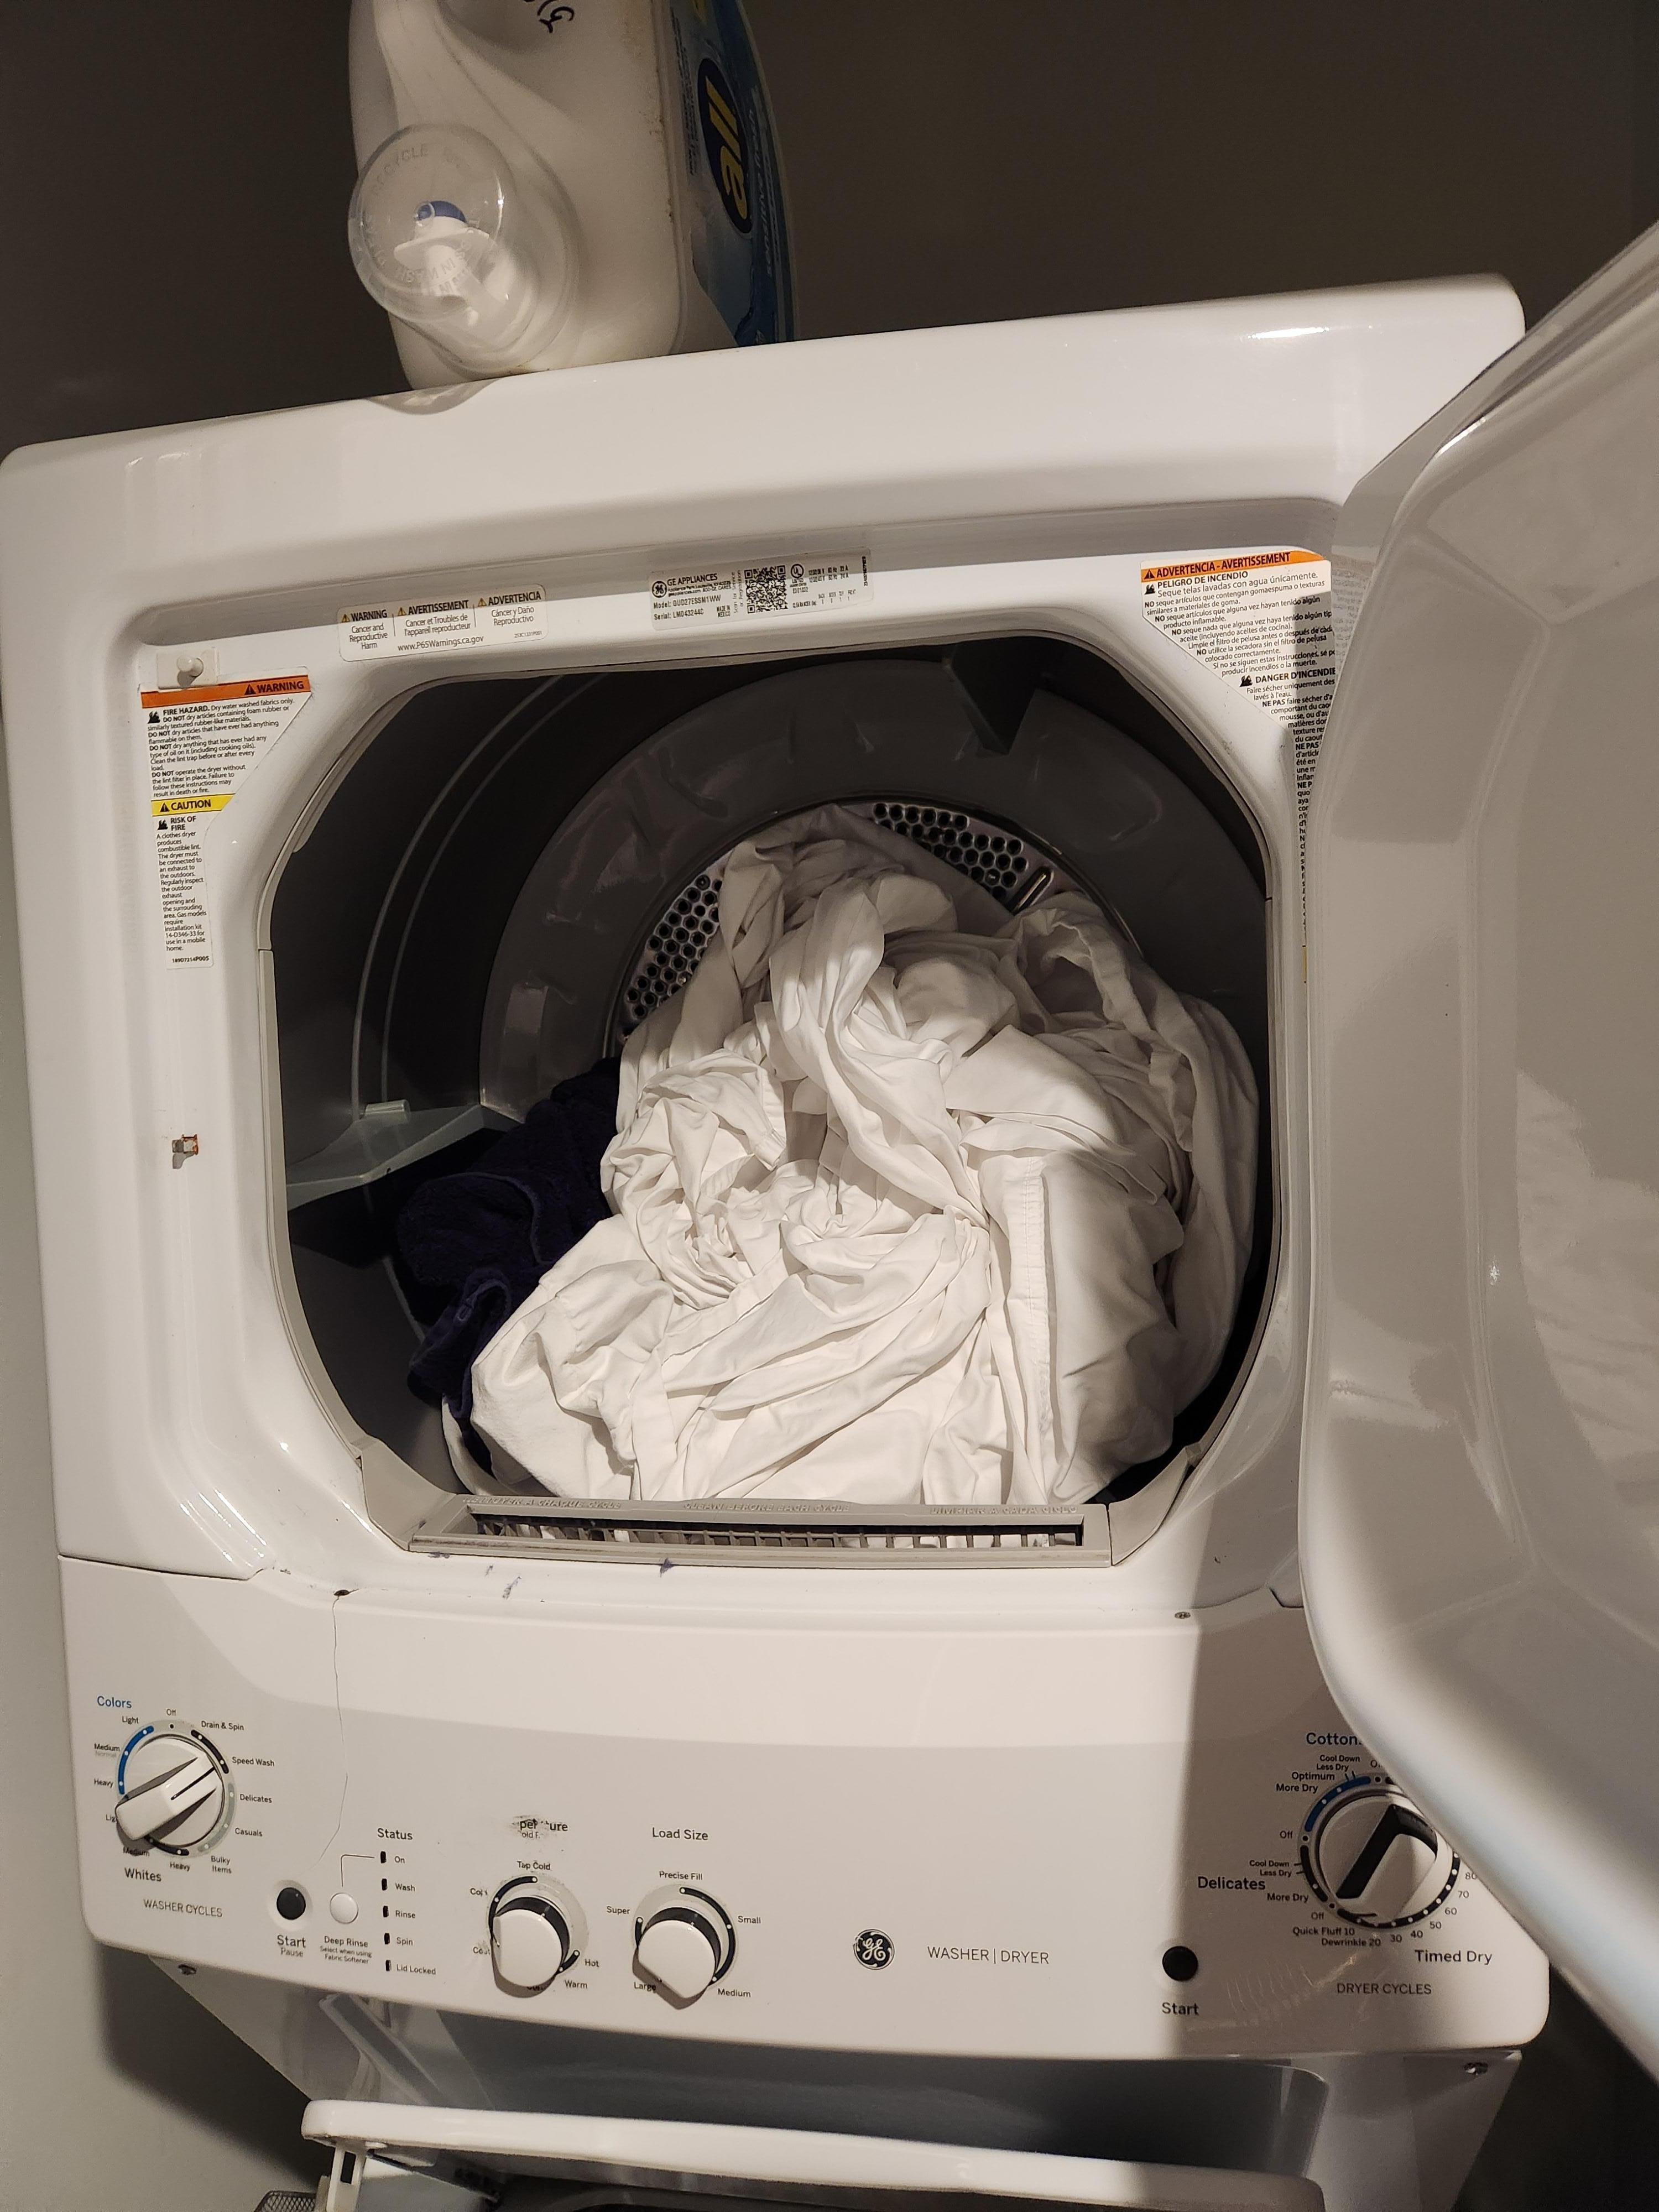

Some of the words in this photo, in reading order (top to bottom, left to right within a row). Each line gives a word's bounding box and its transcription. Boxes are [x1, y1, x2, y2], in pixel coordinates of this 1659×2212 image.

[705, 75, 748, 220] all
[1156, 562, 1215, 578] ADVERTENCIA
[1222, 552, 1290, 570] AVERTISSEMENT
[678, 573, 717, 585] APPLIANCES
[1158, 578, 1192, 588] PELIGRO
[1208, 571, 1248, 582] INCENDIO
[1183, 586, 1200, 594] telas
[1203, 582, 1230, 591] lavadas
[1249, 579, 1267, 587] agua
[1270, 573, 1317, 583] únicamente.
[488, 591, 541, 606] ADVERTENCIA
[408, 600, 468, 615] AVERTISSEMENT
[351, 609, 387, 621] WARNING
[434, 615, 459, 623] Troubles
[494, 615, 533, 625] Reproductivo
[432, 623, 470, 633] reproducteur
[349, 632, 387, 642] Reproductive
[398, 637, 483, 650] www.P65Warnings.ca.gov
[1256, 673, 1288, 683] DANGER
[1291, 667, 1335, 679] D'INCENDIE
[257, 681, 304, 692] WARNING
[171, 800, 211, 810] CAUTION
[97, 1696, 132, 1708] Colors
[122, 1716, 138, 1725] Light
[201, 1720, 219, 1729] Drain
[1306, 1733, 1362, 1745] Cotton
[232, 1756, 254, 1765] Speed
[1334, 1764, 1349, 1772] Dry
[1292, 1772, 1334, 1782] Optimum
[94, 1779, 113, 1788] Heavy
[1302, 1783, 1318, 1794] Dry
[240, 1794, 272, 1803] Delicates
[106, 1814, 117, 1822] Lig
[235, 1828, 262, 1837] Casuals
[378, 1828, 413, 1840] Status
[653, 1828, 680, 1838] Load
[684, 1829, 708, 1840] Size
[1280, 1830, 1293, 1839] Off
[211, 1855, 230, 1865] Bulky
[170, 1863, 190, 1871] Heavy
[212, 1864, 232, 1874] Items
[517, 1861, 530, 1870] Tap
[533, 1861, 550, 1870] Cold
[124, 1868, 161, 1882] Whites
[659, 1871, 688, 1880] Precise
[395, 1883, 415, 1891] Wash
[1198, 1875, 1265, 1890] Delicates
[1267, 1893, 1290, 1901] More
[1293, 1893, 1308, 1903] Dry
[144, 1900, 183, 1912] WASHER
[186, 1904, 222, 1917] CYCLES
[607, 1906, 630, 1914] Super
[395, 1910, 415, 1918] Rinse
[1311, 1912, 1324, 1920] Off
[1293, 1927, 1318, 1937] Quick
[1322, 1927, 1342, 1936] Fluff
[278, 1934, 306, 1948] Start
[325, 1936, 344, 1946] Deep
[347, 1938, 368, 1947] Rinse
[397, 1937, 413, 1945] Spin
[1322, 1938, 1366, 1947] Dewrinkle
[1369, 1938, 1381, 1947] 20
[1391, 1934, 1402, 1943] 30
[281, 1947, 303, 1957] Pause
[356, 1950, 372, 1958] using
[927, 1947, 989, 1961] WASHER
[1001, 1950, 1048, 1964] DRYER
[325, 1953, 342, 1961] Fabric
[344, 1956, 369, 1964] Softener
[1415, 1950, 1461, 1962] Timed
[1467, 1951, 1492, 1965] Dry
[585, 1959, 599, 1967] Hot
[410, 1965, 436, 1975] Locked
[565, 1980, 587, 1989] Warm
[634, 1982, 656, 1994] Large
[1337, 1983, 1379, 1994] DRYER
[1383, 1983, 1432, 1995] CYCLES
[718, 1988, 750, 1997] Medium
[1162, 2002, 1198, 2015] Start
